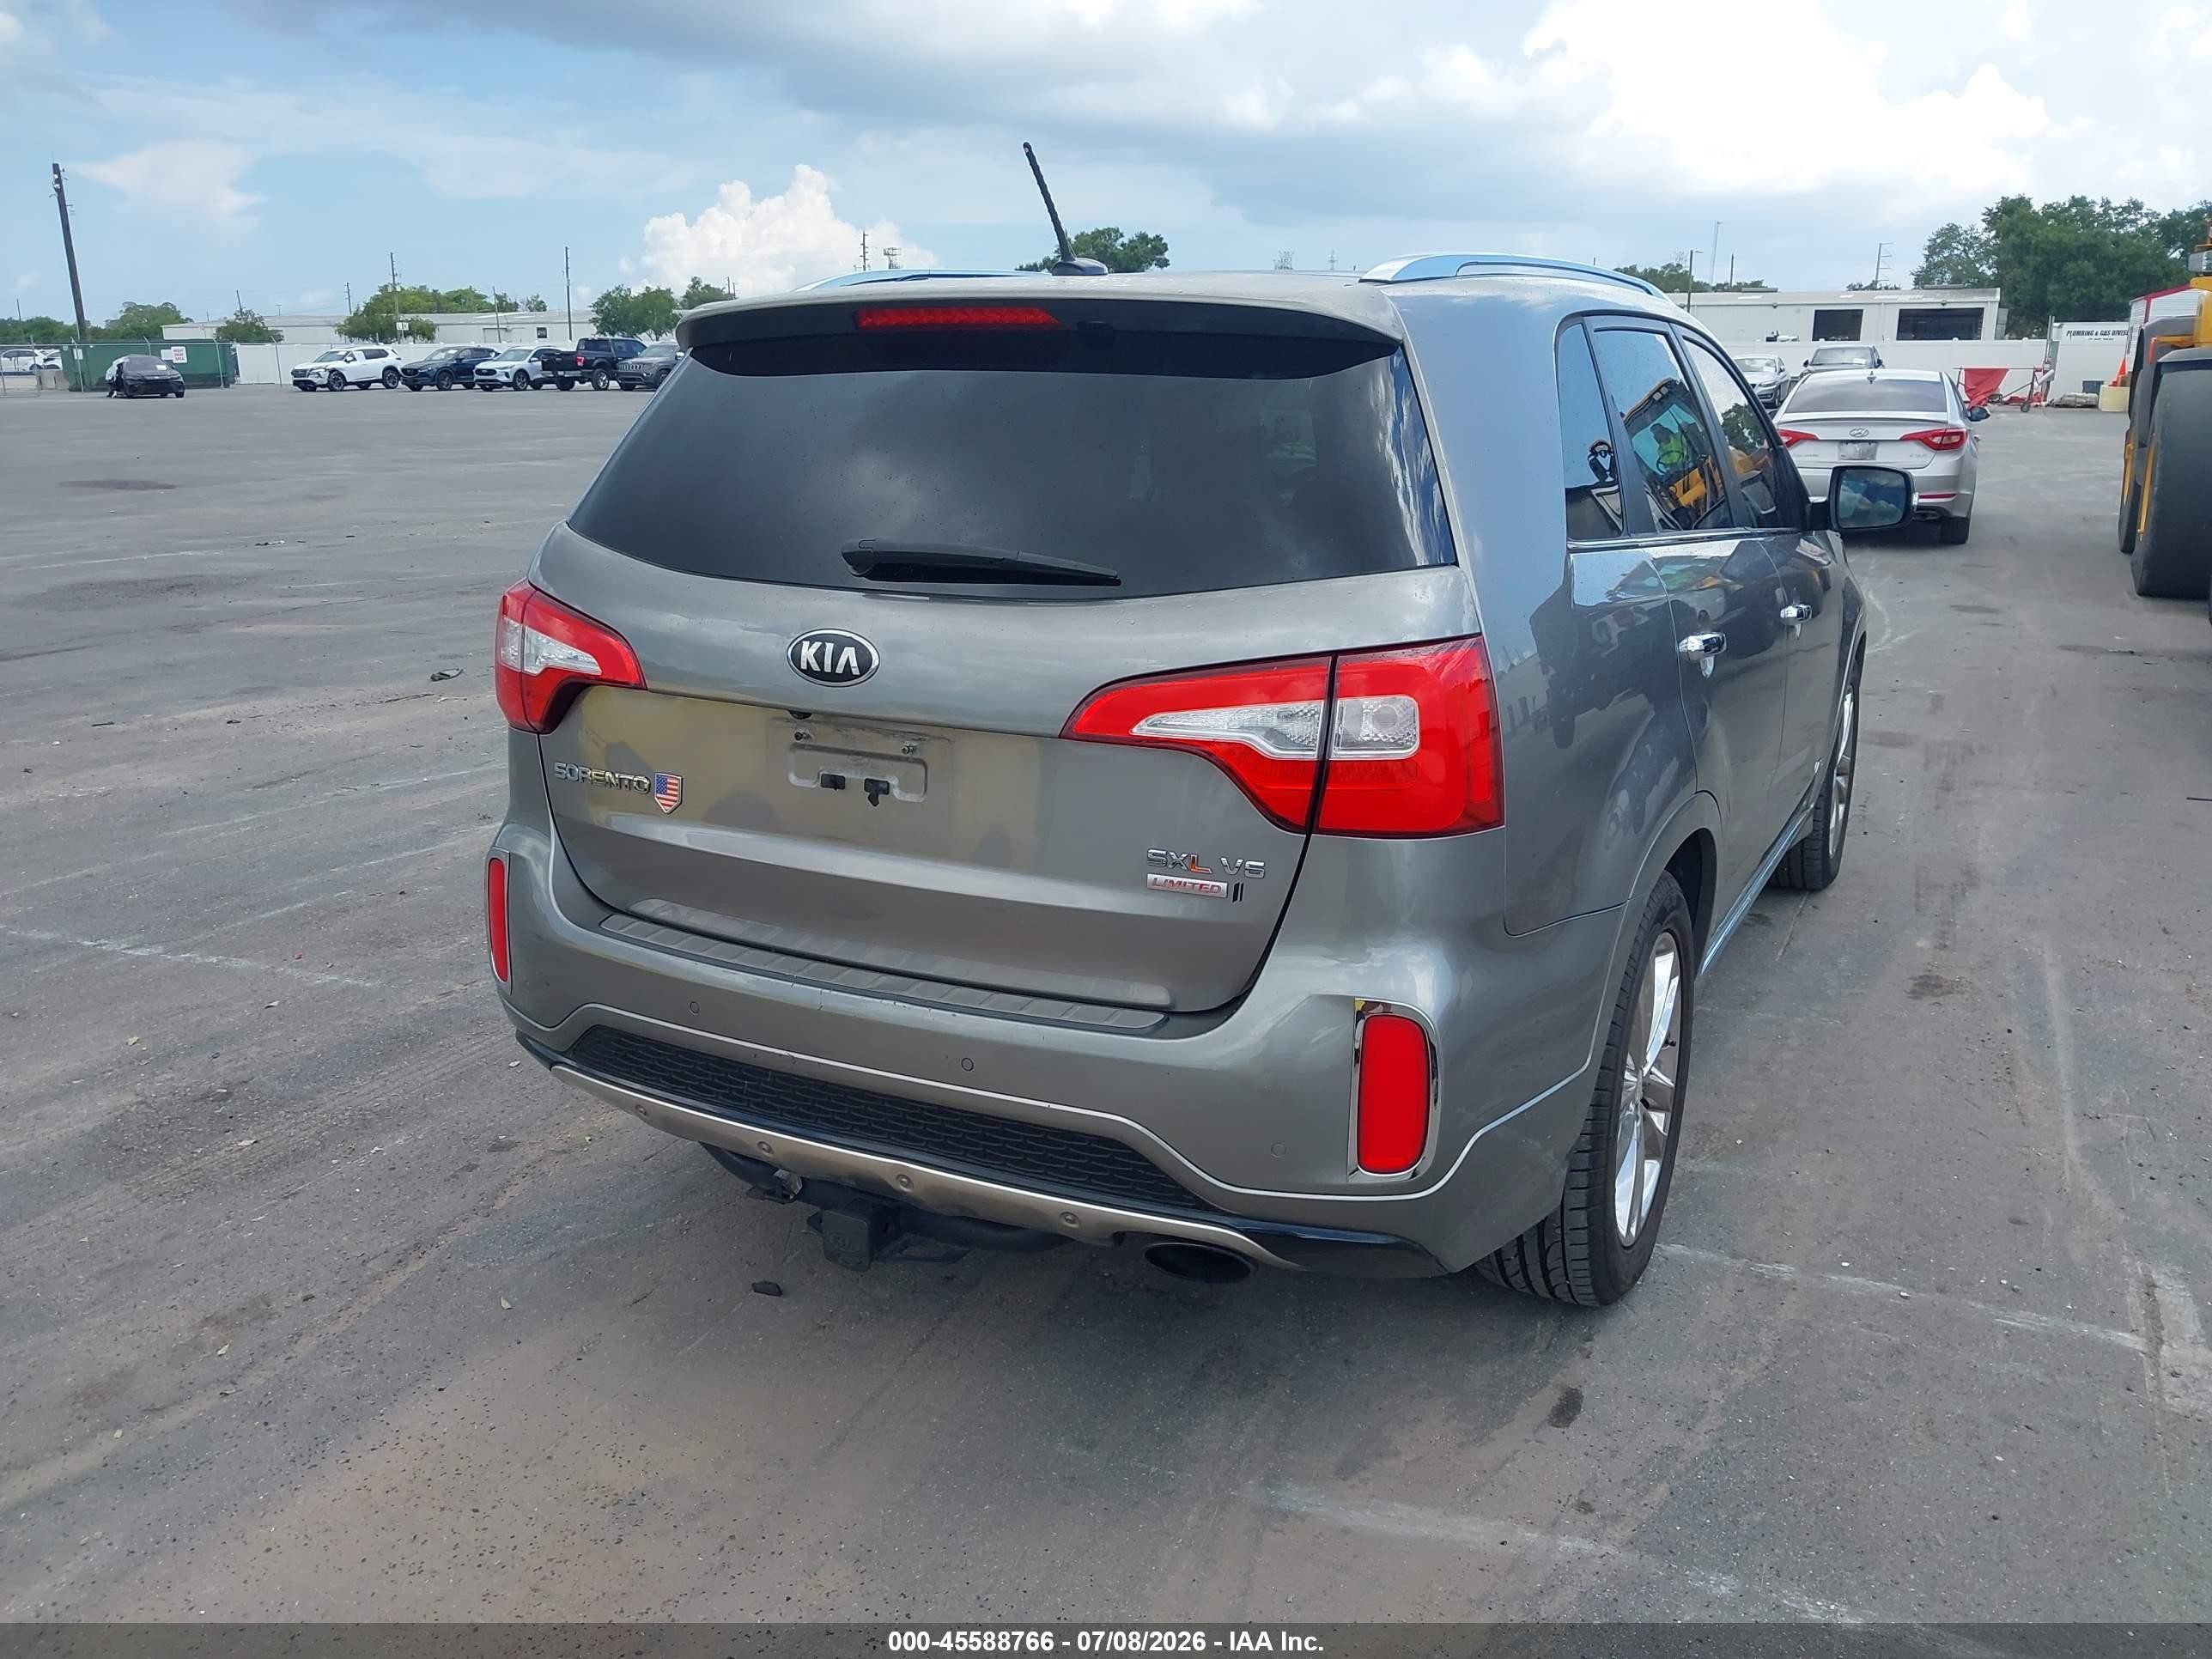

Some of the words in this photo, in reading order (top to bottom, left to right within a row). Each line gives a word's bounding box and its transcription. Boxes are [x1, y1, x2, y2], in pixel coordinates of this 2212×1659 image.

[800, 641, 860, 676] KIA
[554, 762, 652, 794] SORENTO
[1146, 848, 1213, 874] SXL
[1220, 857, 1266, 878] V6
[1152, 877, 1223, 895] LIMITED
